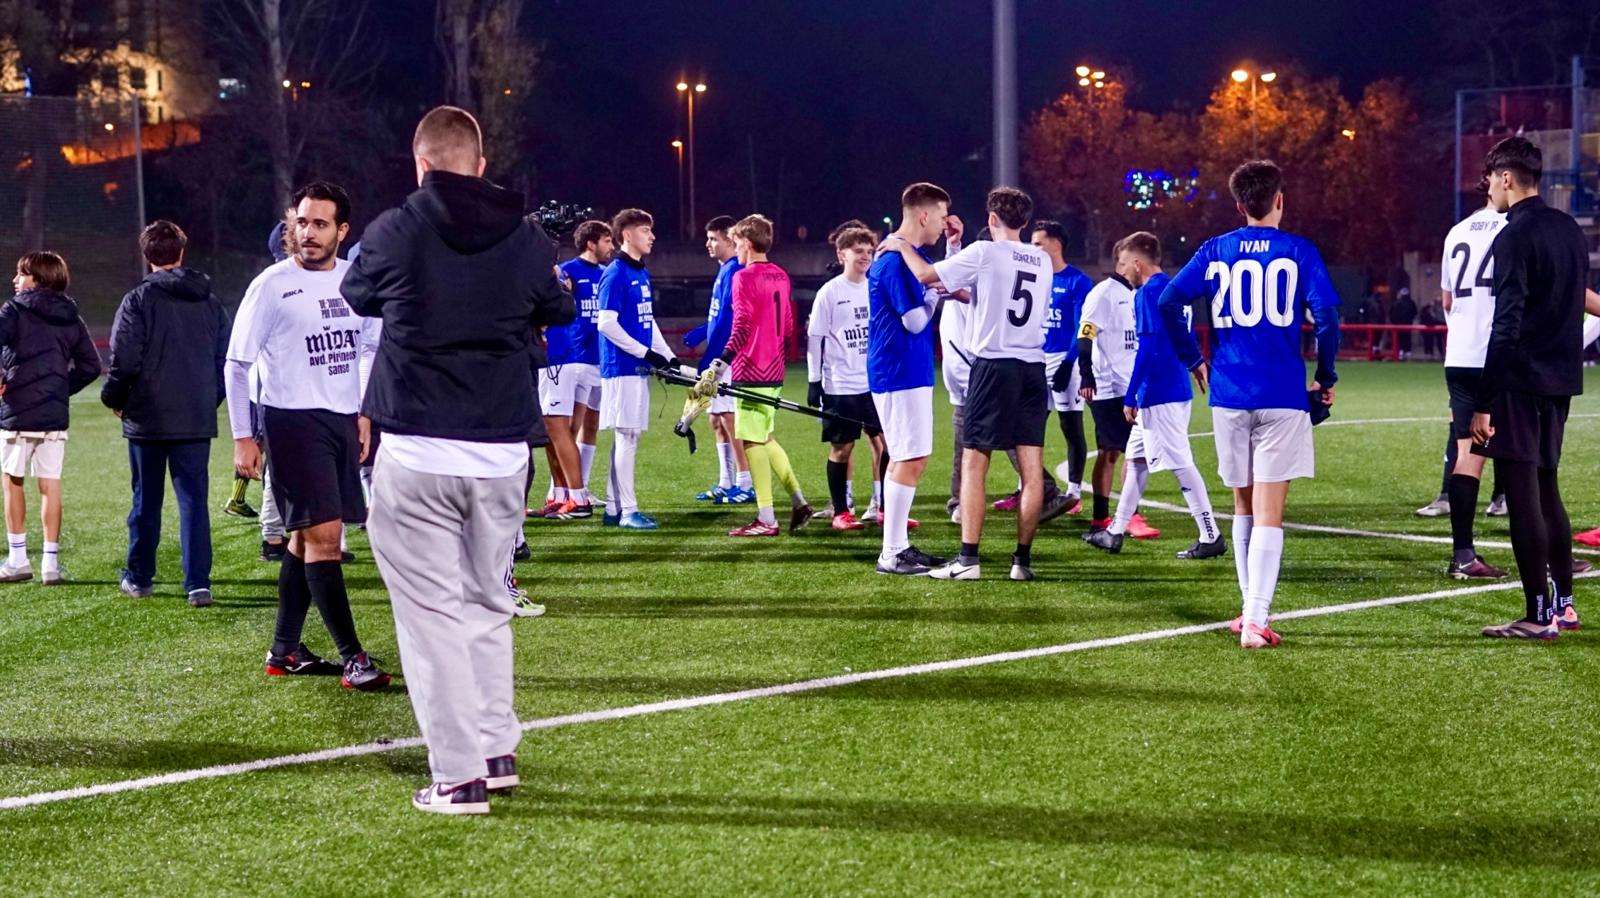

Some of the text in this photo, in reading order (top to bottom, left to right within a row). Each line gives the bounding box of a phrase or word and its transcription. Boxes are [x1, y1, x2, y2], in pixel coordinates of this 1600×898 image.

[1239, 239, 1270, 253] IVAN
[1451, 242, 1496, 298] 24
[773, 290, 782, 337] 1
[1006, 269, 1037, 327] 5
[1204, 257, 1299, 329] 200
